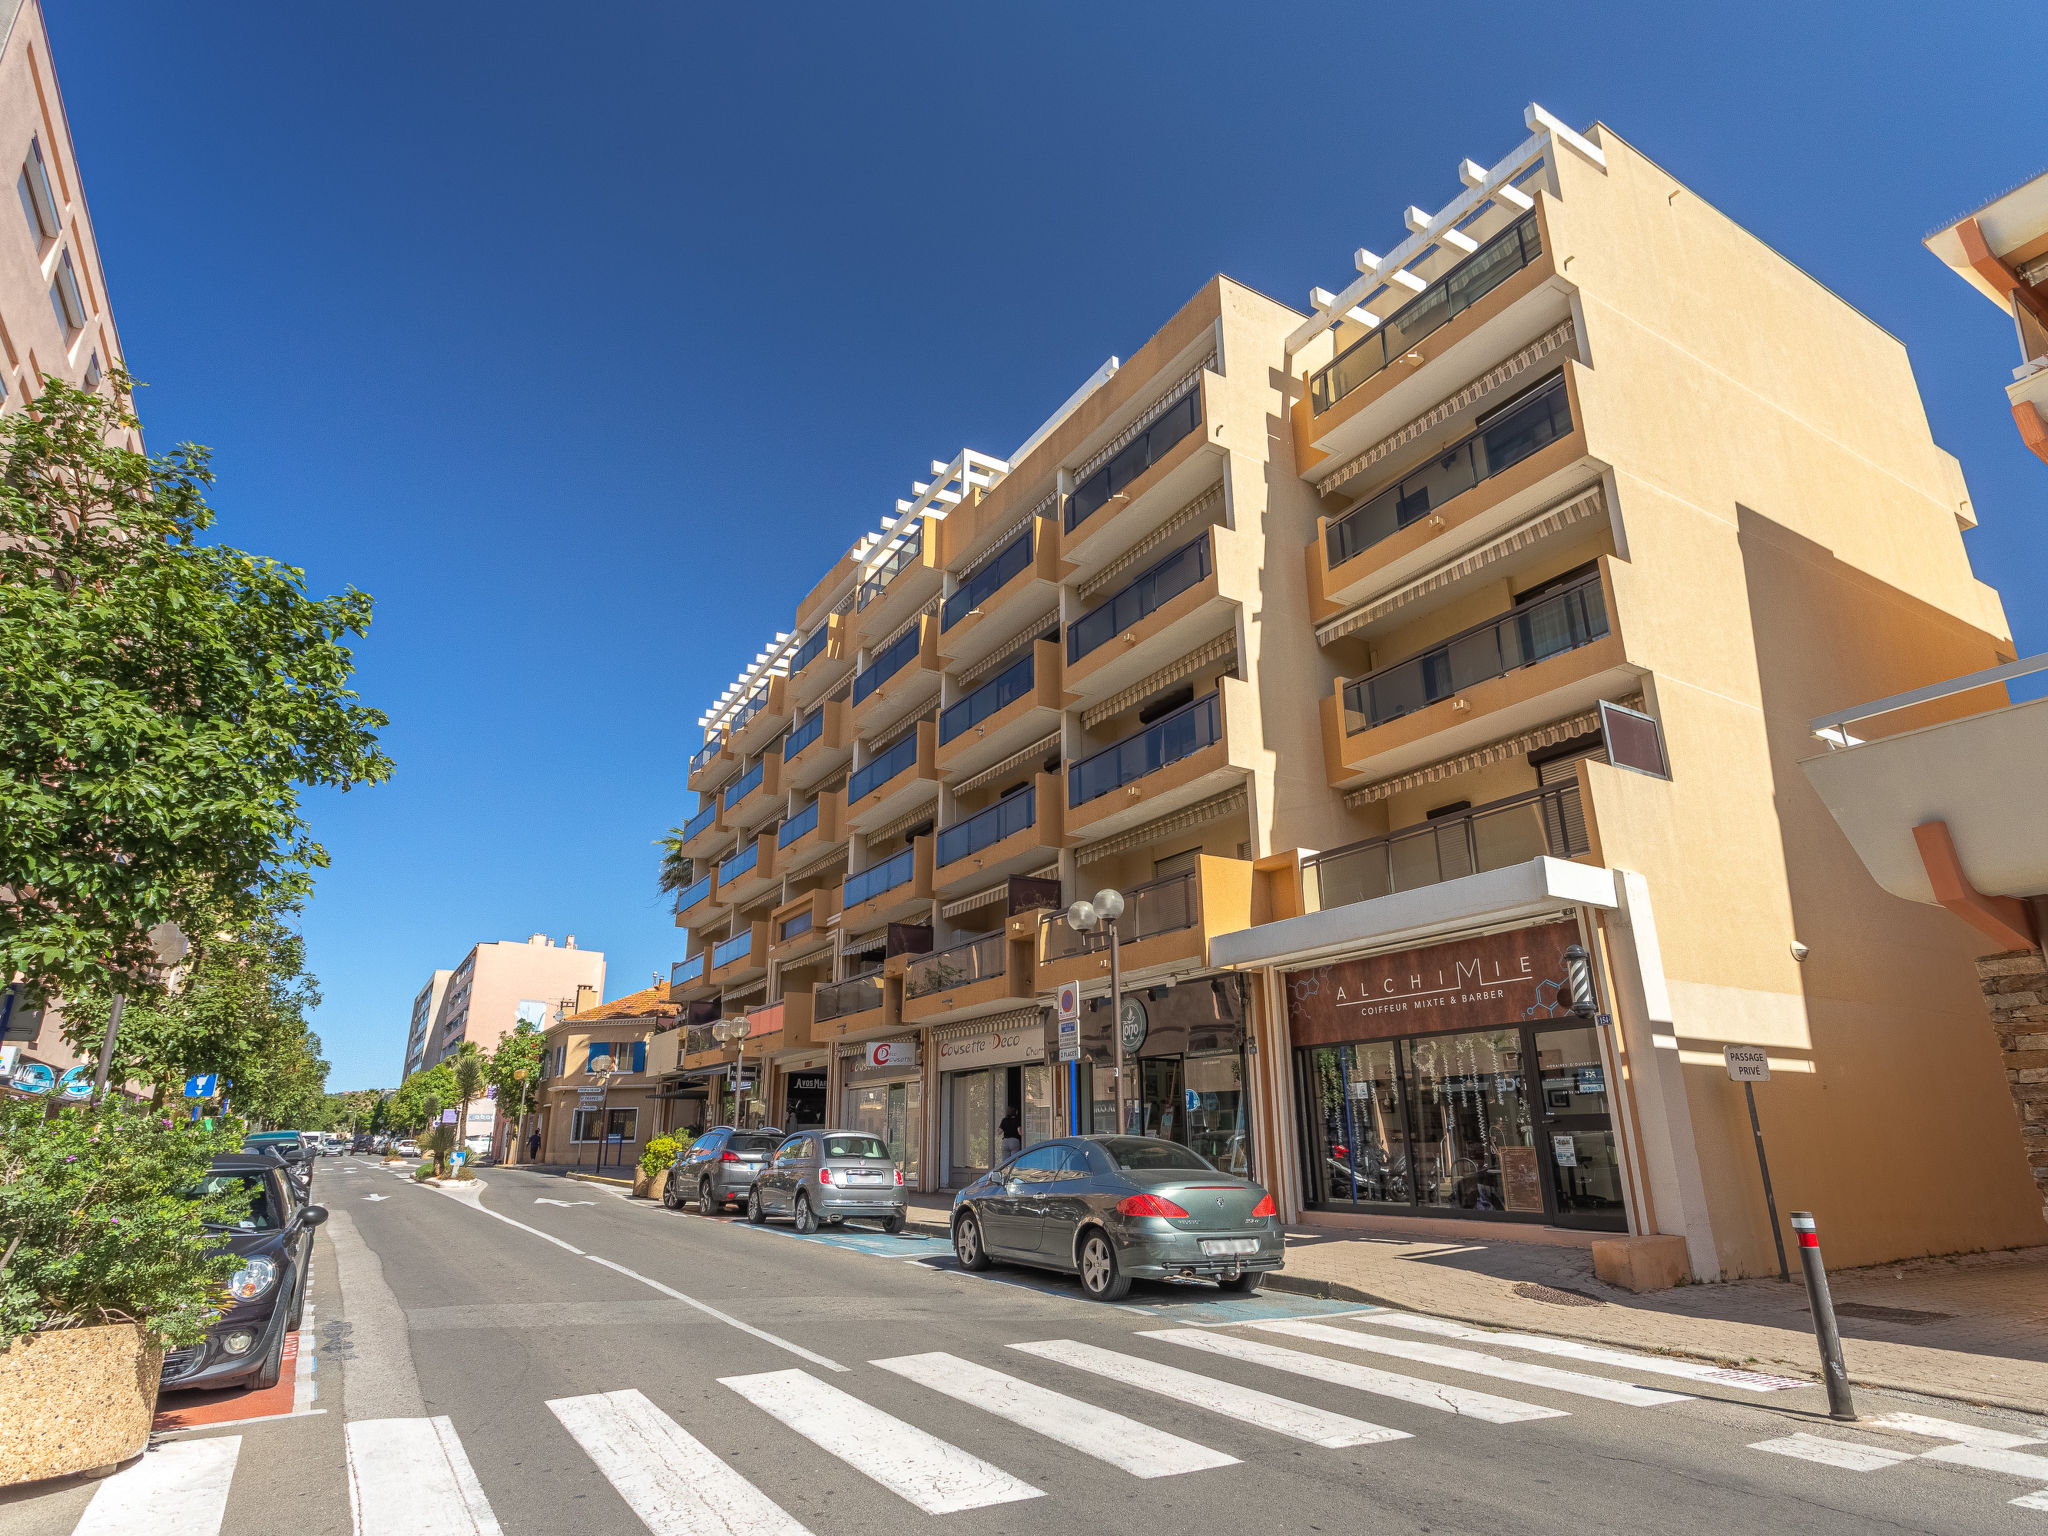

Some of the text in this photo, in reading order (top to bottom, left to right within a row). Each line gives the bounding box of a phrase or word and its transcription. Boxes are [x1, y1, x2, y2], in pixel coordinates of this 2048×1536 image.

[1336, 955, 1533, 1001] ALCHIMIE
[1361, 989, 1504, 1016] COIFFEUR MIXTE & BARBER
[940, 1032, 1021, 1058] Cousette Déco
[1730, 1052, 1764, 1062] PASSAGE
[1738, 1065, 1761, 1076] PRIVÉ
